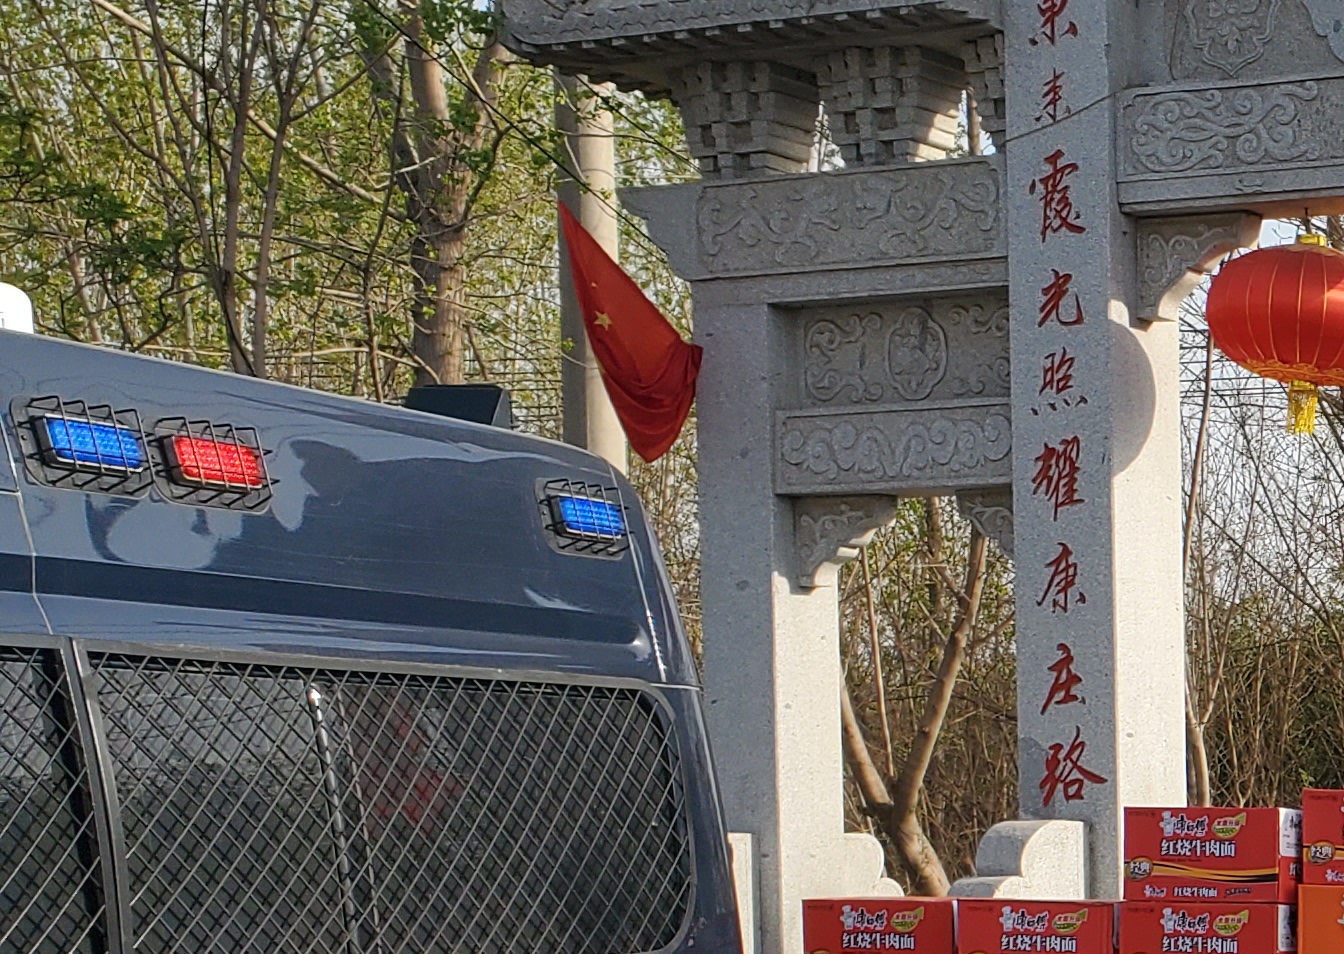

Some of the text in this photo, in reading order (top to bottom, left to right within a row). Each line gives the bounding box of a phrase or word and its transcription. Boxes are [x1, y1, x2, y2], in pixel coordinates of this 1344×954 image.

[1161, 840, 1236, 857] 红烧牛肉面
[843, 934, 915, 950] 红烧牛肉面
[1001, 935, 1076, 952] 红烧牛肉面
[1163, 937, 1237, 954] 红烧牛肉面
